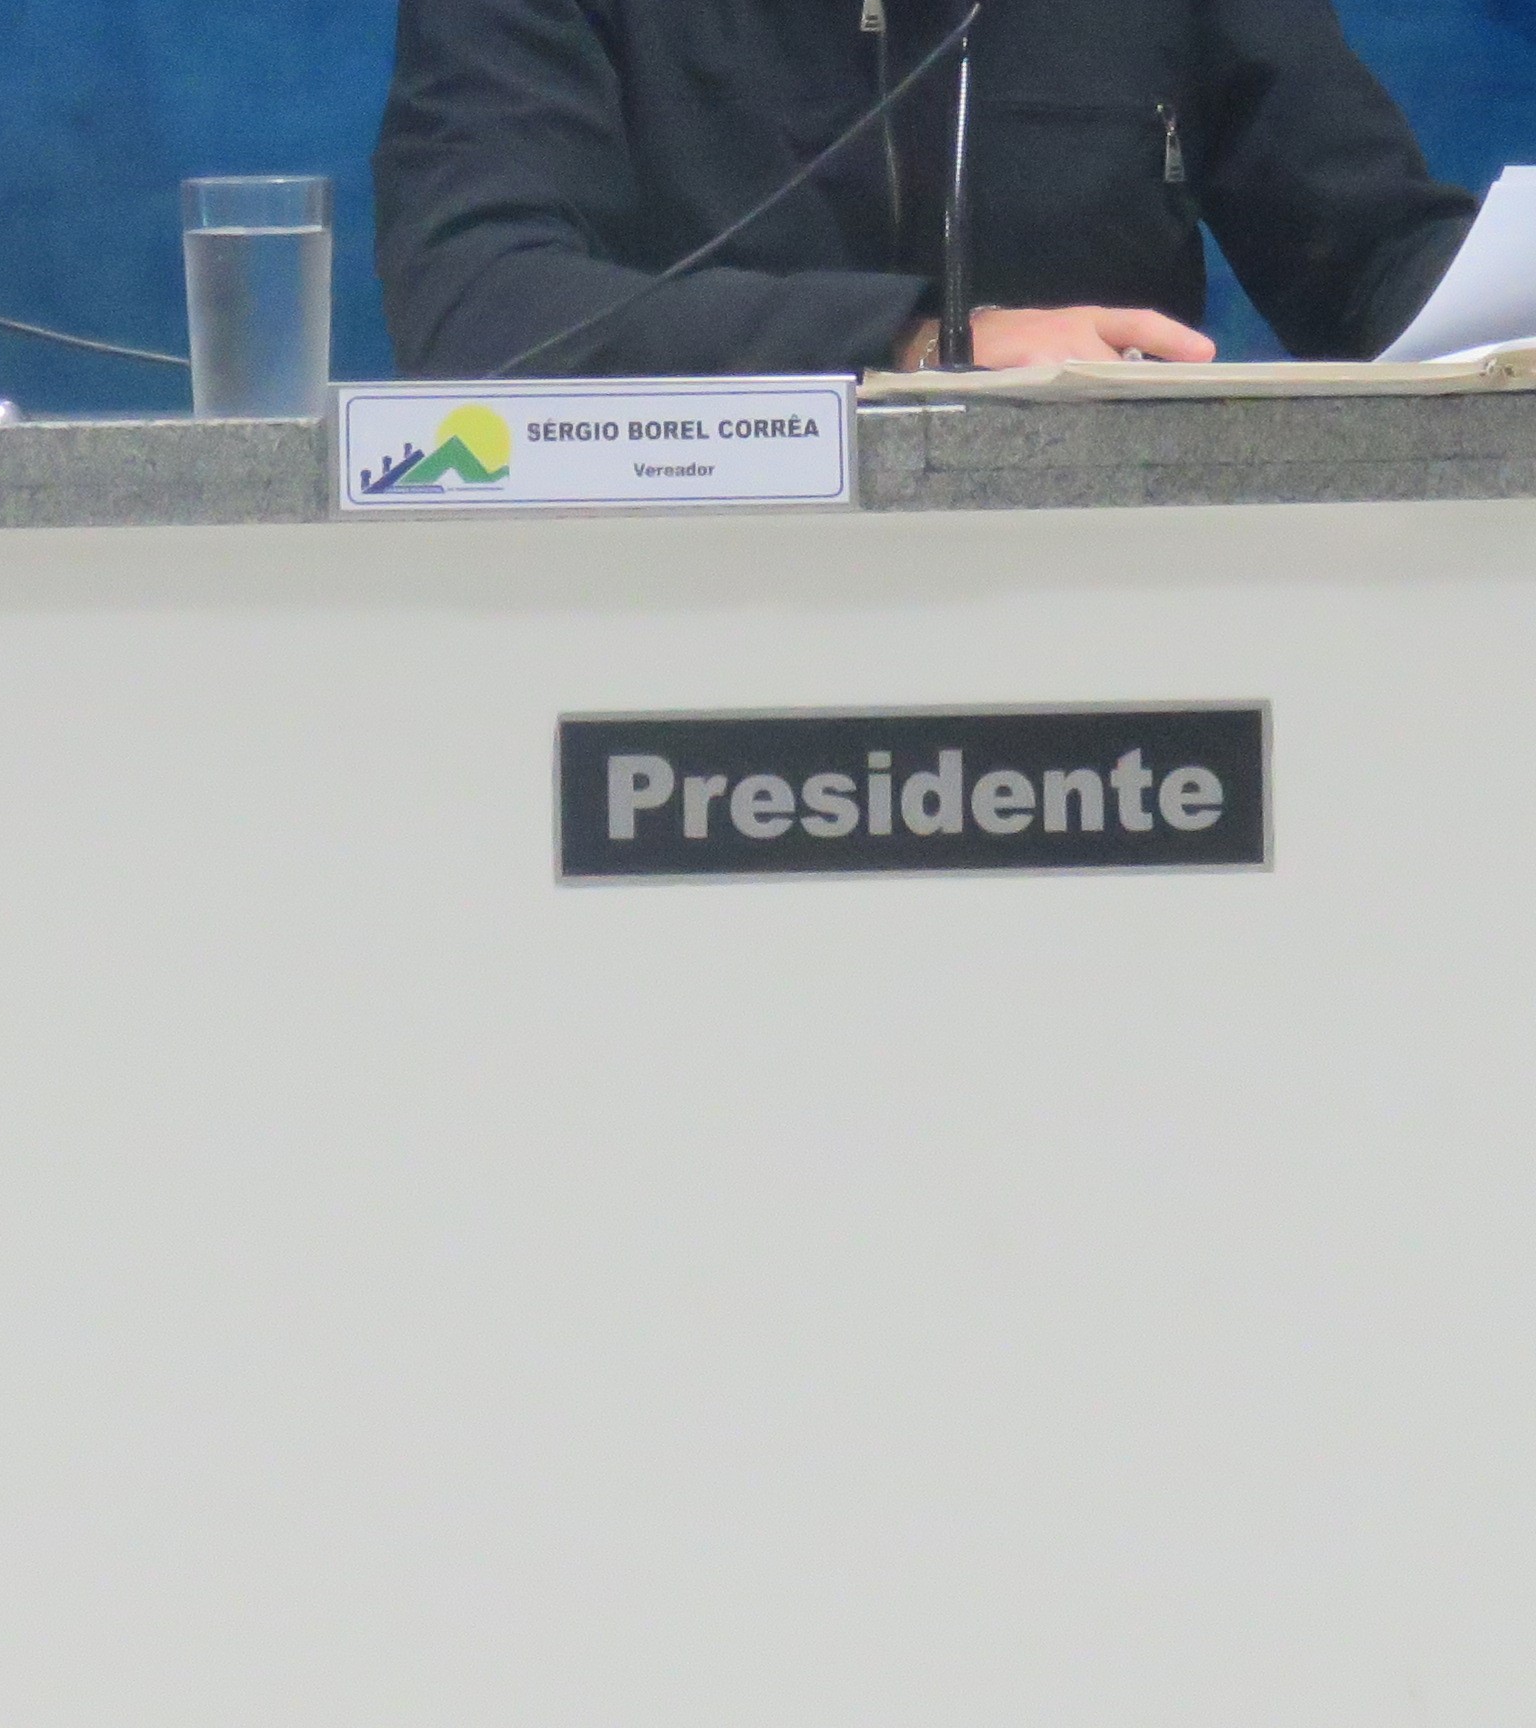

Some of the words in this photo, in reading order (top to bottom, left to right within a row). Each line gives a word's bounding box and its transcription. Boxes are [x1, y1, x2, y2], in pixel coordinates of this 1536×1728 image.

[526, 417, 620, 443] SÉRGIO
[627, 419, 710, 441] BOREL
[717, 414, 819, 440] CORRÊA
[633, 461, 716, 478] Vereador
[607, 747, 1224, 840] Presidente
